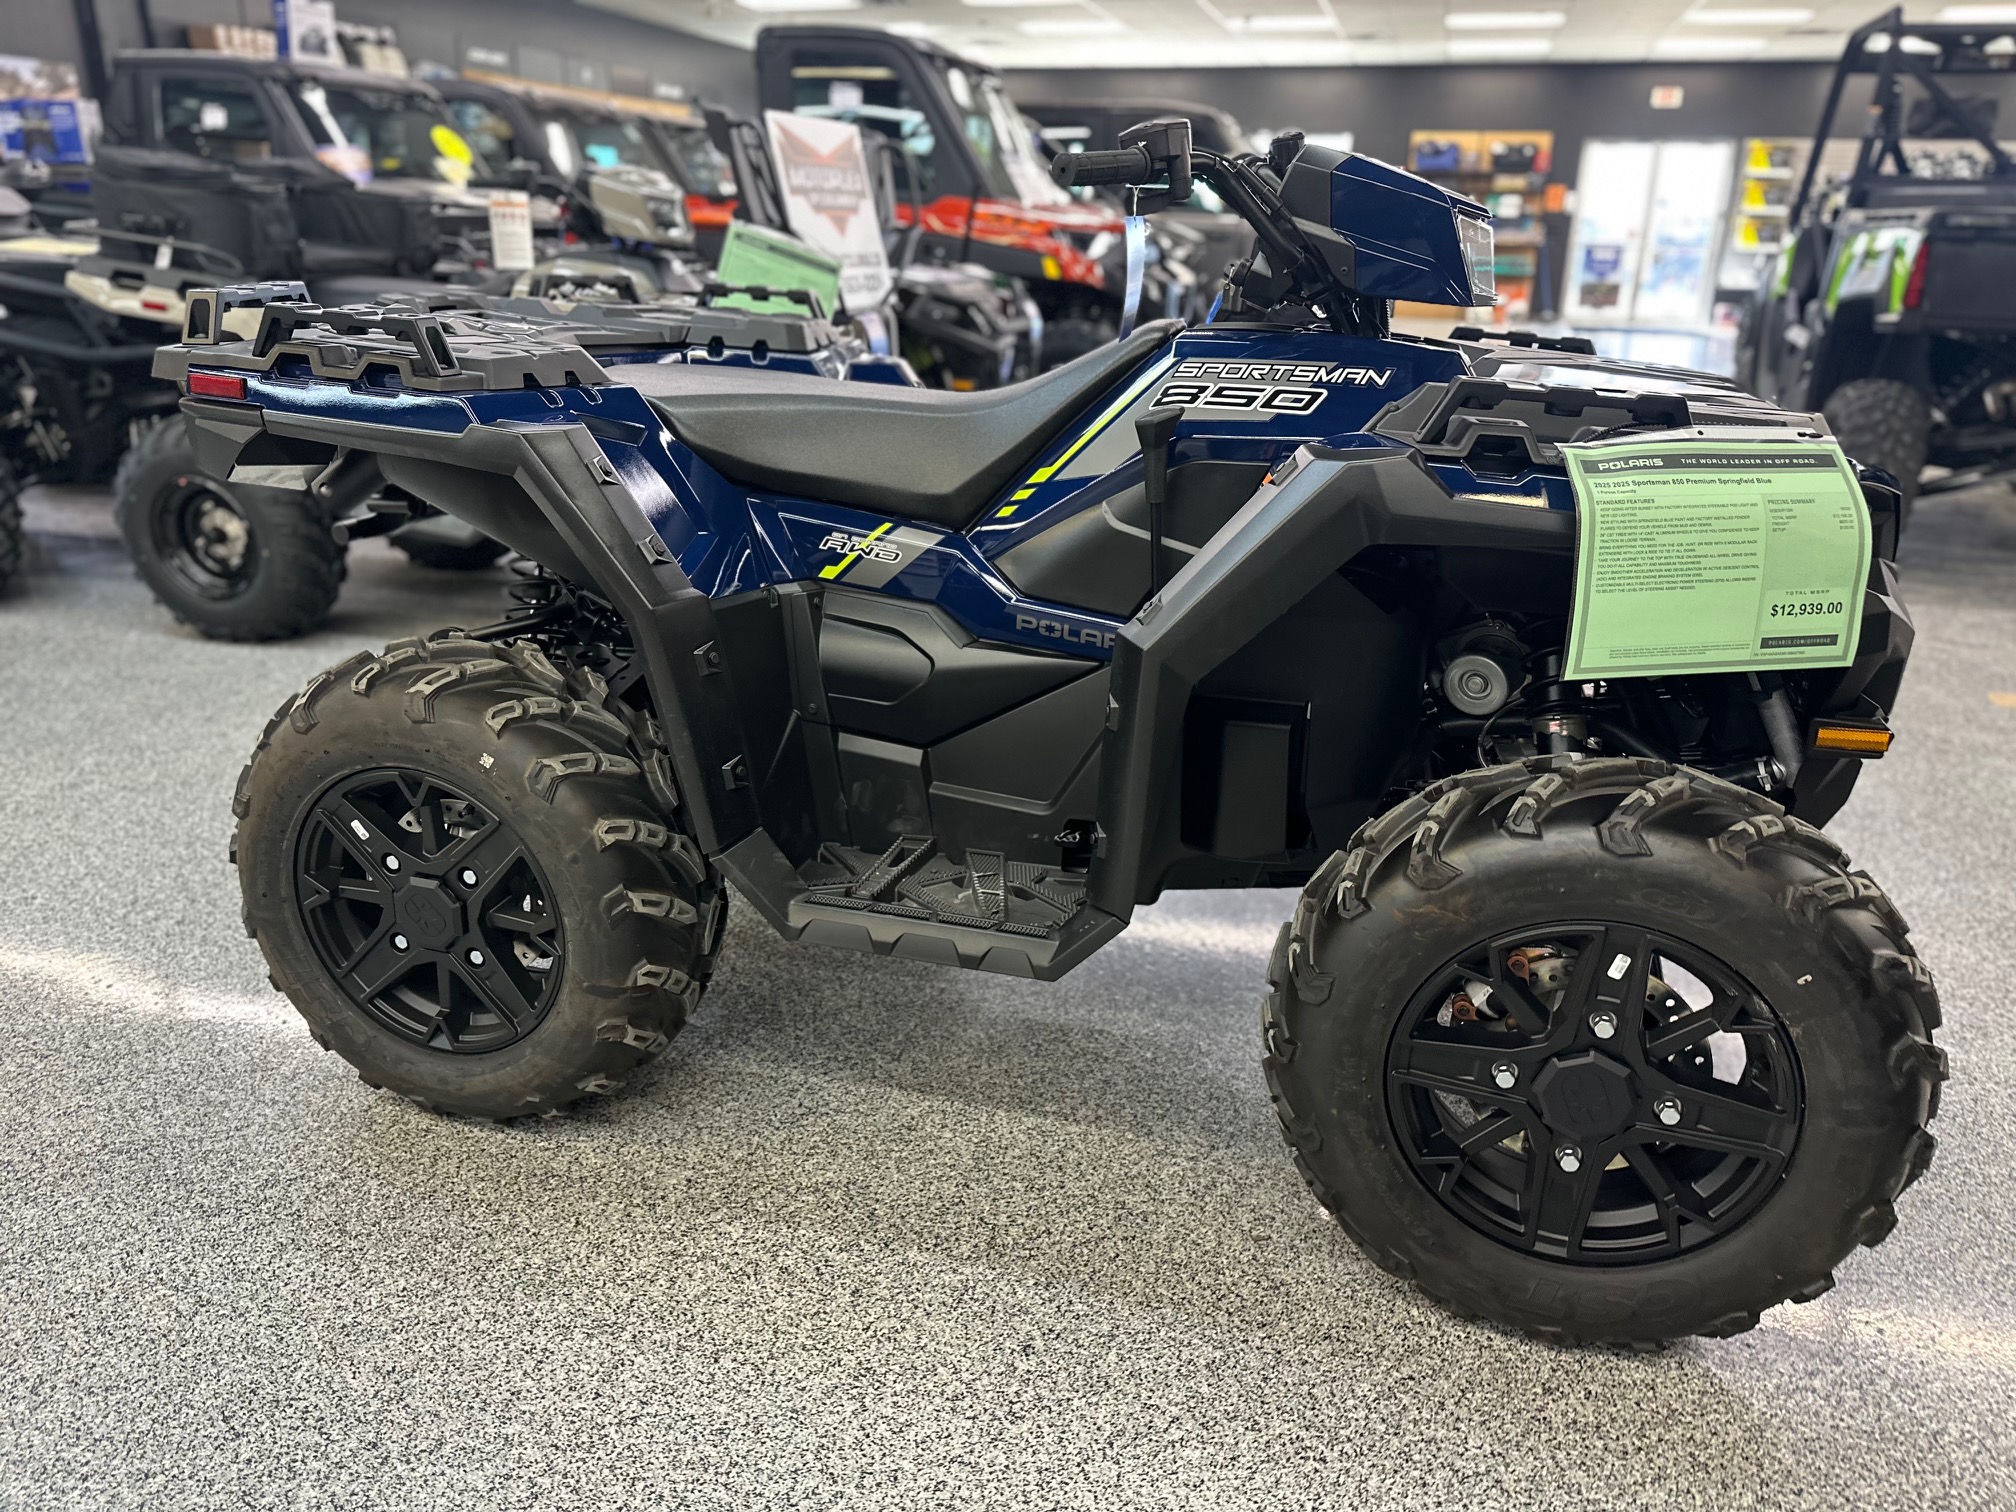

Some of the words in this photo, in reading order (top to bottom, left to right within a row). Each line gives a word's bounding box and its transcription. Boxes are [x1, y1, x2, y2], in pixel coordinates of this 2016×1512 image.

[1174, 361, 1394, 388] SPORTSMAN
[1149, 382, 1329, 415] 850
[1598, 458, 1664, 470] POLARIS
[1613, 480, 1630, 488] 2025
[1632, 479, 1671, 487] Sportsman
[1718, 477, 1755, 485] Springfield
[819, 536, 902, 563] AWD
[1770, 602, 1843, 618] $12,939.00
[1769, 638, 1831, 646] POLARIS.COM/OFFROAD
